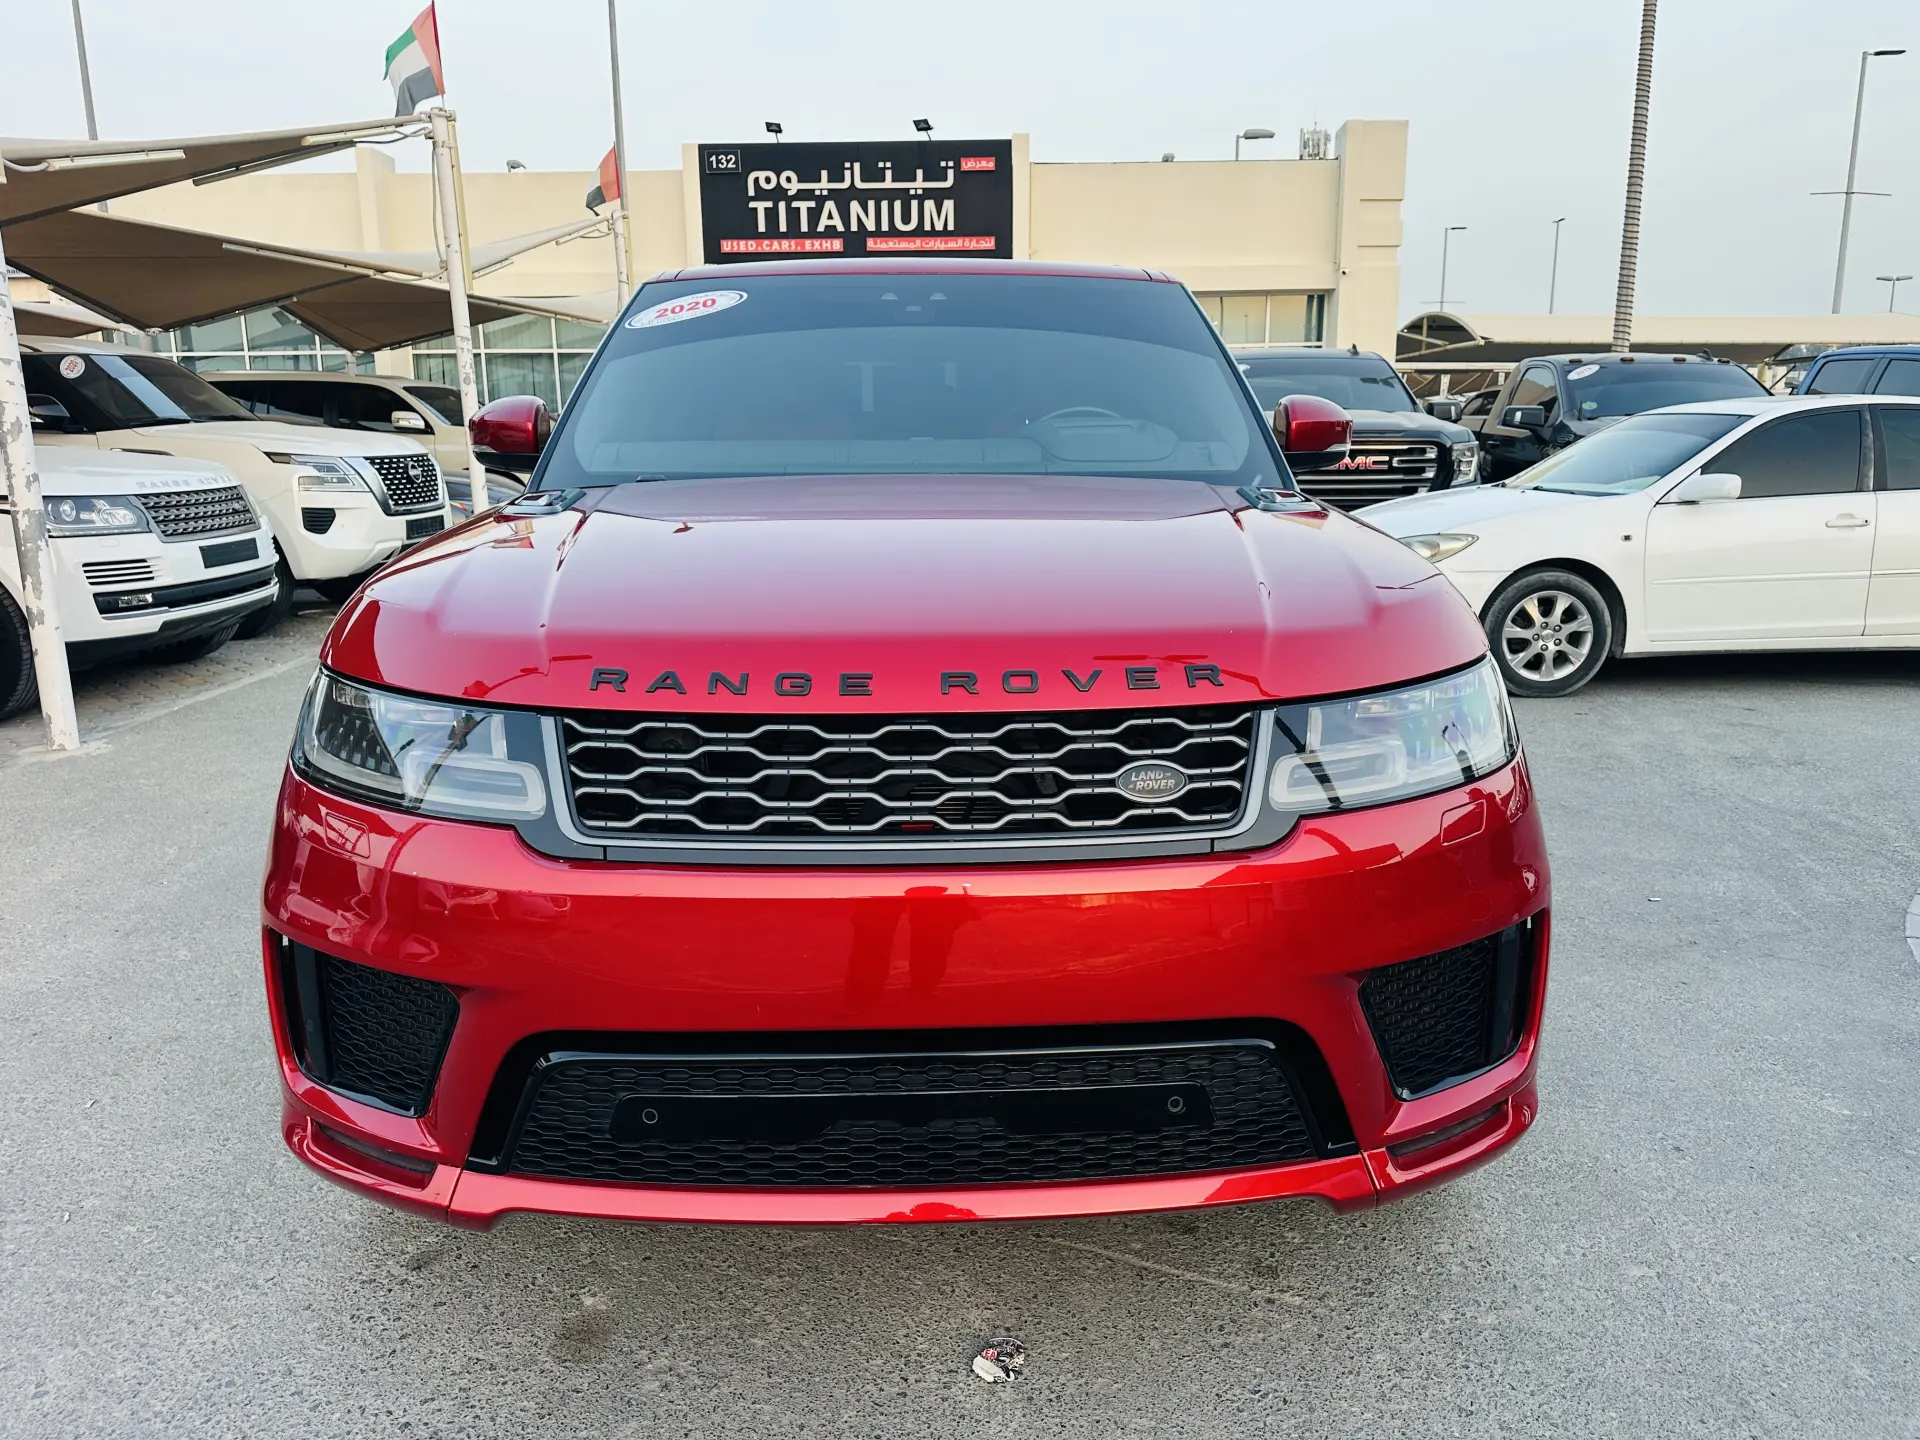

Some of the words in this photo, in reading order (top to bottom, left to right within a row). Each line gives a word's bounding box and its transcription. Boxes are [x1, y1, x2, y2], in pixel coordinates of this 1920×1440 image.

[709, 154, 736, 169] 132
[962, 159, 994, 169] معرض
[747, 160, 955, 197] تيتانيوم
[748, 199, 955, 233] TITANIUM
[804, 239, 841, 250] EXHB
[867, 239, 921, 249] المستعملة
[922, 239, 963, 250] السيارات
[963, 238, 995, 249] لتجارة
[655, 298, 717, 319] 2020
[589, 668, 873, 696] RANGE
[940, 663, 1224, 695] ROVER
[1131, 771, 1164, 781] LAND
[1135, 780, 1176, 791] ROVER
